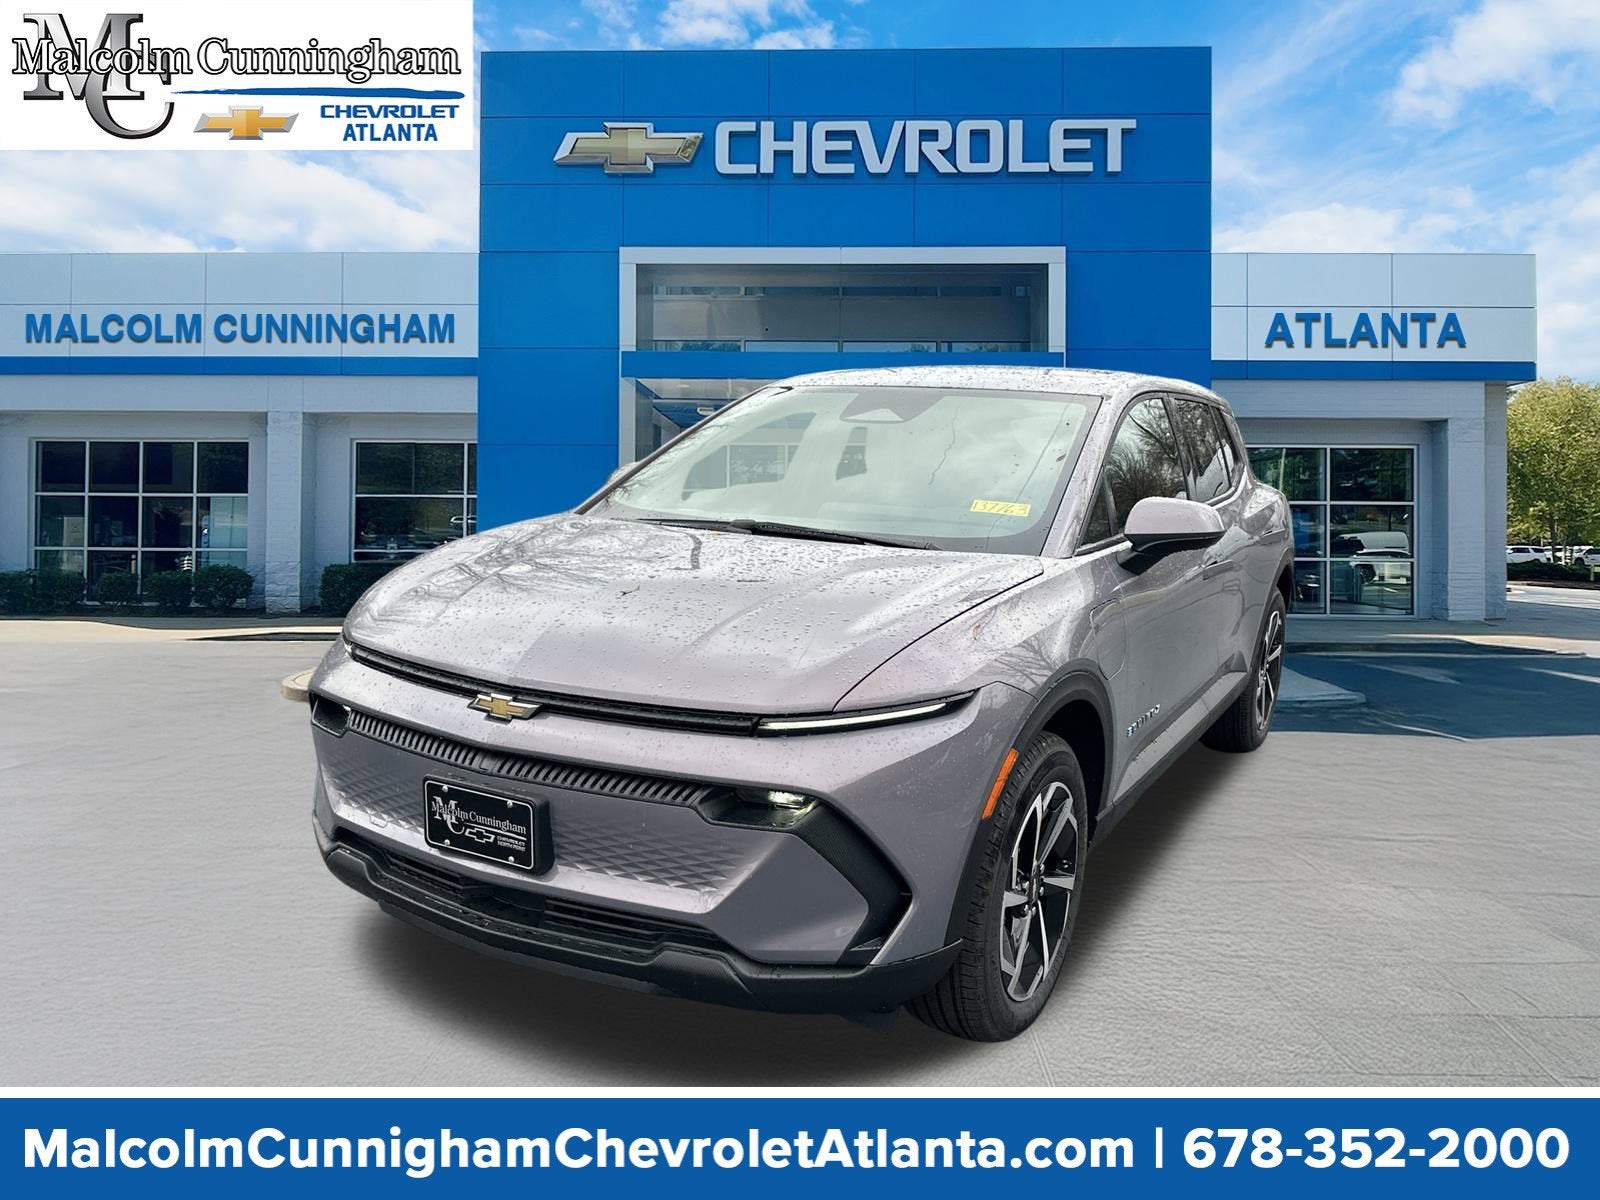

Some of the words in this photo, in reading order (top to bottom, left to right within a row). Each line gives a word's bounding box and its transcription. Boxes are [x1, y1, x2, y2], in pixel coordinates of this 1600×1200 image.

[716, 119, 1137, 175] CHEVROLET
[25, 313, 202, 343] MALCOLM
[213, 313, 455, 343] CUNNINGHAM
[1265, 312, 1467, 348] ATLANTA
[432, 801, 469, 821] Malcolm
[469, 811, 527, 835] Cunningham
